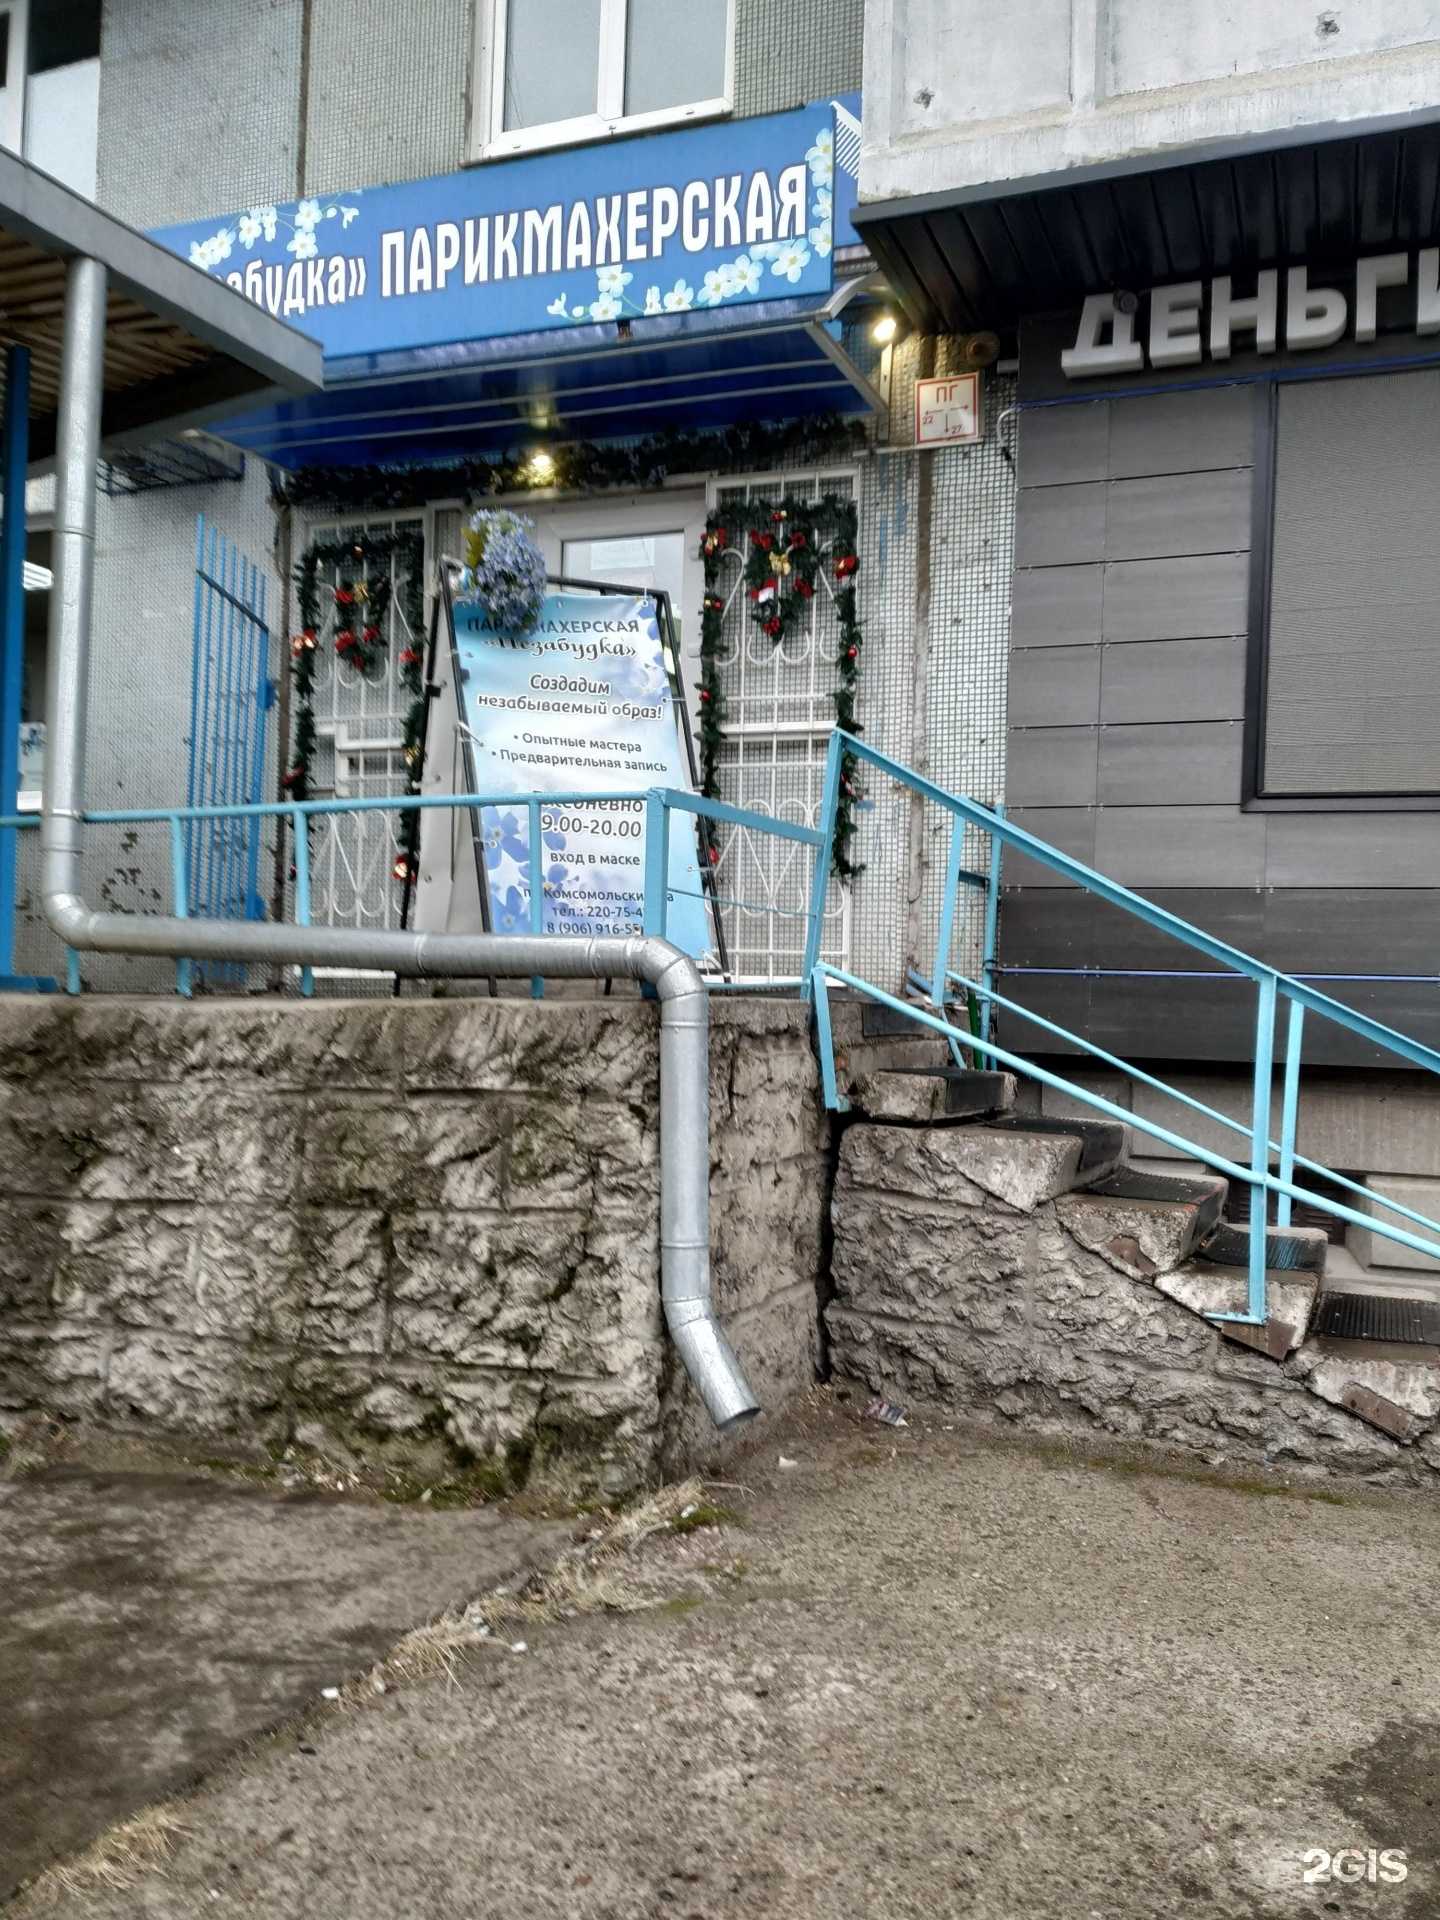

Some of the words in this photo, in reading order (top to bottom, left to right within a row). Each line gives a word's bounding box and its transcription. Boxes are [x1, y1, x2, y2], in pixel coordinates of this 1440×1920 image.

[213, 254, 368, 320] будка»
[381, 164, 807, 298] ПАРИКМАХЕРСКАЯ
[936, 384, 959, 404] ПГ
[467, 617, 640, 634] ПАРМАХЕРСКАЯ
[530, 674, 610, 694] Создадим
[478, 695, 607, 715] незабываемый
[612, 704, 662, 719] образ!
[522, 732, 586, 748] Опытные
[589, 740, 642, 754] мастера
[500, 750, 622, 770] Предварительная
[624, 760, 668, 772] запись
[542, 815, 642, 837] 9.00-20.00
[550, 852, 585, 866] вход
[588, 855, 596, 864] в
[600, 856, 641, 866] маске
[544, 887, 644, 902] Комсомольски
[552, 907, 584, 917] тел.:
[587, 905, 643, 919] 220-75-4
[547, 921, 555, 934] 8
[559, 922, 592, 935] (906)
